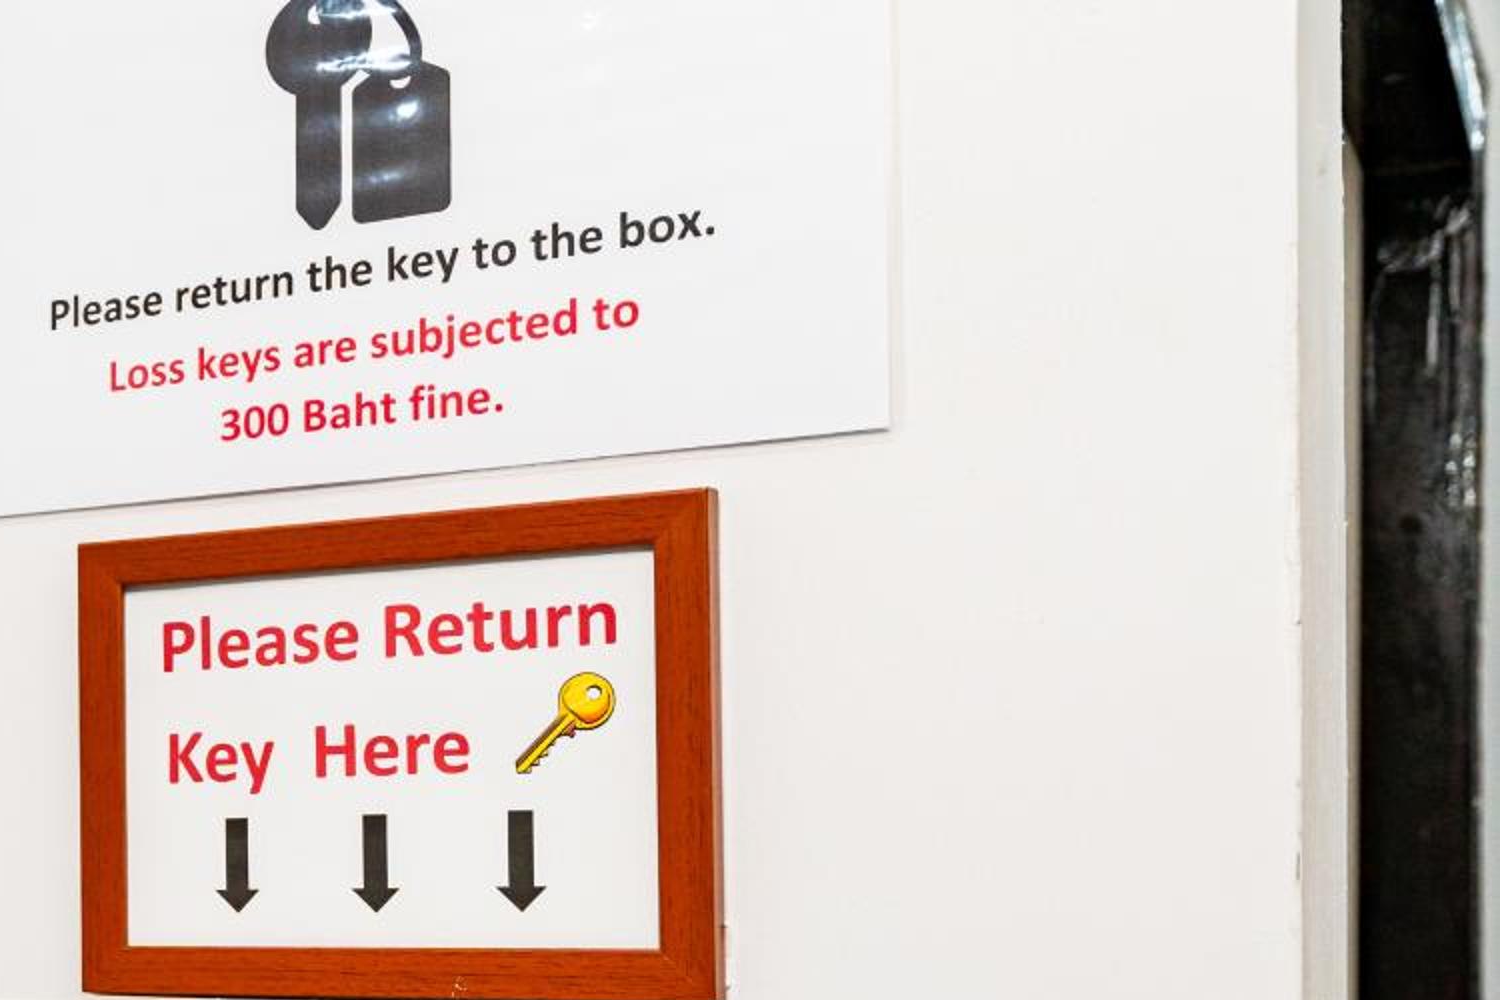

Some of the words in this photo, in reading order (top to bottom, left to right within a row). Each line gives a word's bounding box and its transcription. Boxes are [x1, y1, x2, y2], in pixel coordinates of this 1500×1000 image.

[51, 291, 163, 331] Please
[175, 271, 294, 313] return
[305, 255, 373, 293] the
[387, 246, 459, 284] key
[472, 237, 517, 270] to
[529, 221, 603, 261] the
[619, 210, 715, 249] box.
[110, 359, 185, 392] Loss
[198, 346, 281, 383] keys
[293, 337, 357, 368] are
[371, 297, 578, 360] subjected
[592, 298, 639, 331] to
[220, 403, 290, 442] 300
[303, 392, 397, 433] Baht
[408, 384, 503, 421] fine.
[163, 616, 359, 673] Please
[384, 602, 617, 658] Return
[169, 732, 274, 795] Key
[315, 724, 470, 778] Here
